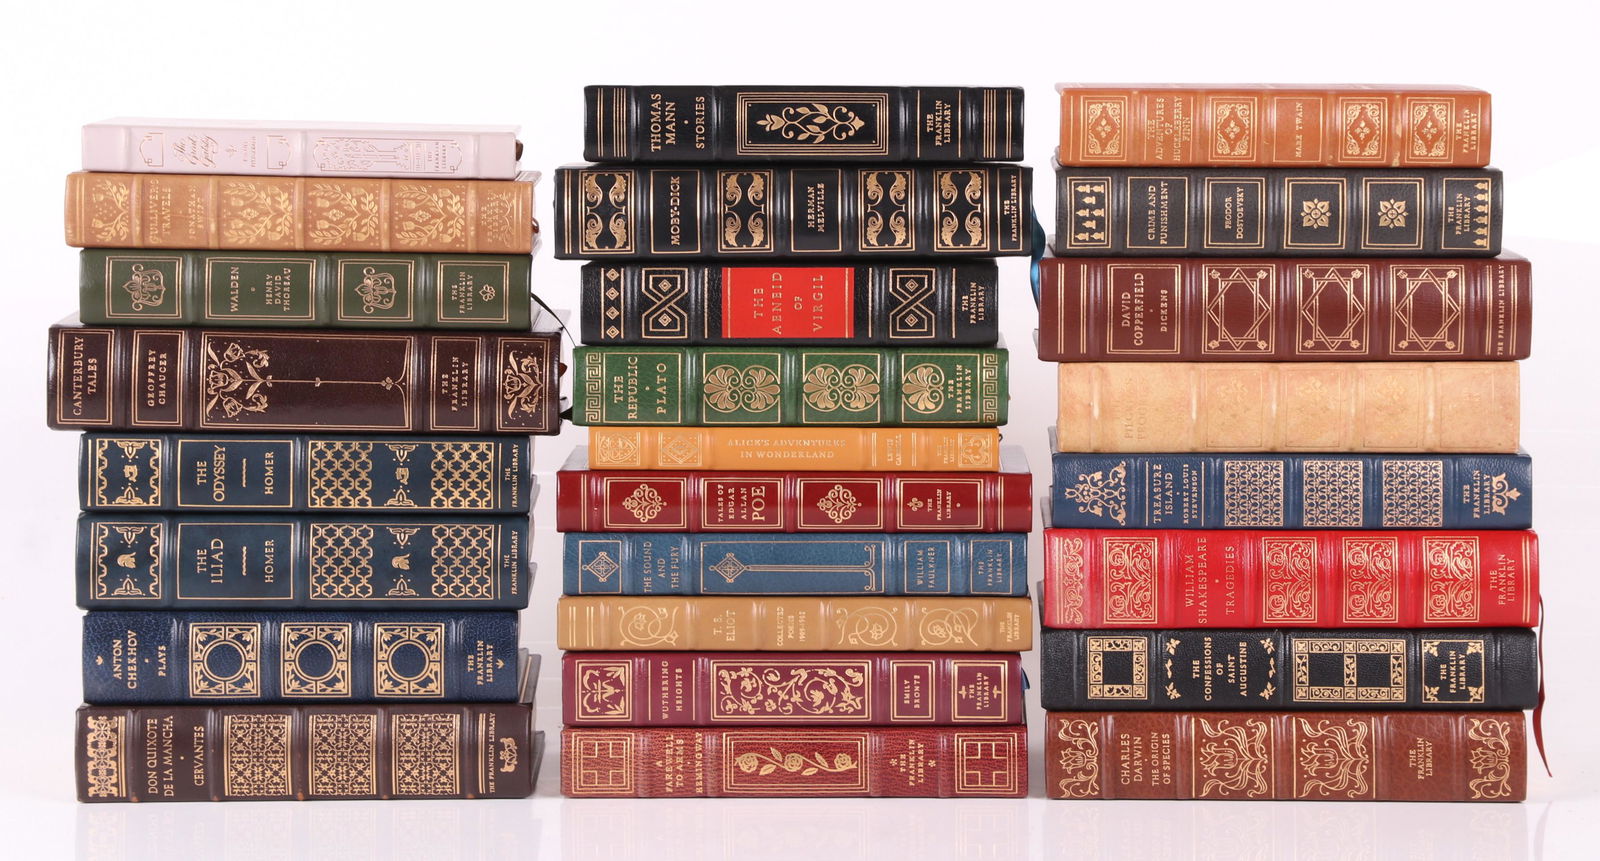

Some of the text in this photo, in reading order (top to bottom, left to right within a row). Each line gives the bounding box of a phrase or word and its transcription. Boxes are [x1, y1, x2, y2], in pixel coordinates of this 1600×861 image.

[651, 93, 661, 152] THOMAS
[665, 101, 676, 145] MANN
[695, 96, 705, 149] STORIES
[1147, 119, 1155, 140] THE
[1156, 97, 1164, 161] ADVENTURES
[1165, 123, 1173, 135] OF
[1183, 117, 1191, 141] FINN
[199, 134, 218, 168] Gatsby
[161, 187, 171, 236] TRAVELS
[670, 176, 680, 246] MOBY-DICK
[807, 186, 815, 228] HERMAN
[817, 183, 825, 232] MELVILLE
[1148, 185, 1156, 241] CRIME AND
[1160, 181, 1168, 245] PUNISHMENT
[1236, 186, 1244, 240] DOSTOEVSKY
[230, 266, 240, 312] WALDEN
[283, 267, 291, 312] THOREAU
[753, 288, 764, 319] THE
[772, 272, 782, 335] AENEID
[794, 296, 803, 311] OF
[812, 275, 823, 333] VIRGIL
[1122, 291, 1131, 328] DAVID
[1133, 272, 1144, 346] COPPERFIELD
[1160, 289, 1168, 332] DICKENS
[73, 337, 84, 416] CANTERBURY
[88, 357, 98, 395] TALES
[147, 350, 156, 407] GEOFFREY
[159, 353, 167, 405] CHAUCER
[613, 375, 624, 404] THE
[628, 356, 638, 420] REPUBLIC
[656, 362, 667, 415] PLATO
[196, 460, 207, 486] THE
[213, 444, 226, 502] ODYSSEY
[264, 450, 274, 495] HOMER
[740, 450, 835, 459] IN WONDERLAND
[717, 484, 724, 497] OF
[752, 485, 766, 521] POE
[1153, 464, 1162, 524] TREASURE
[1164, 472, 1173, 515] ISLAND
[1182, 463, 1190, 525] ROBERT LOUIS
[1473, 470, 1481, 519] FRANKLIN
[1483, 474, 1491, 515] LIBRARY
[196, 548, 207, 574] THE
[211, 537, 224, 584] ILIAD
[264, 539, 274, 583] HOMER
[643, 541, 652, 593] THE SOUND
[657, 558, 666, 579] AND
[670, 545, 679, 589] THE FURY
[1185, 554, 1194, 608] WILLIAM
[1198, 536, 1208, 624] SHAKESPEARE
[1225, 545, 1235, 616] TRAGEDIES
[1489, 570, 1498, 590] THE
[1498, 554, 1506, 606] FRANKLIN
[1507, 558, 1515, 602] LIBRARY
[726, 610, 736, 642] ELIOT
[113, 639, 122, 680] ANTON
[127, 630, 138, 689] CHEKHOV
[158, 645, 167, 677] PLAYS
[467, 654, 475, 672] THE
[486, 644, 494, 682] LIBRARY
[1192, 659, 1200, 679] THE
[1204, 636, 1212, 701] CONFESSIONS
[1216, 662, 1224, 676] OF
[1228, 654, 1236, 684] SAINT
[1239, 641, 1247, 697] AUGUSTINE
[661, 660, 670, 720] WUTHERING
[675, 667, 683, 712] HEIGHTS
[147, 718, 158, 794] DON QUIXOTE
[163, 715, 174, 797] DE LA MANCHA
[194, 726, 204, 786] CERVANTES
[665, 734, 674, 793] FAREWELL
[676, 739, 684, 788] TO ARMS
[695, 732, 703, 793] HEMINGWAY
[1121, 733, 1130, 785] CHARLES
[1133, 736, 1142, 782] DARWIN
[1151, 731, 1160, 787] THE ORIGIN
[1161, 733, 1171, 785] OF SPECIES
[1409, 749, 1417, 768] THE
[1417, 737, 1425, 780] FRANKLIN
[1425, 741, 1433, 777] LIBRARY
